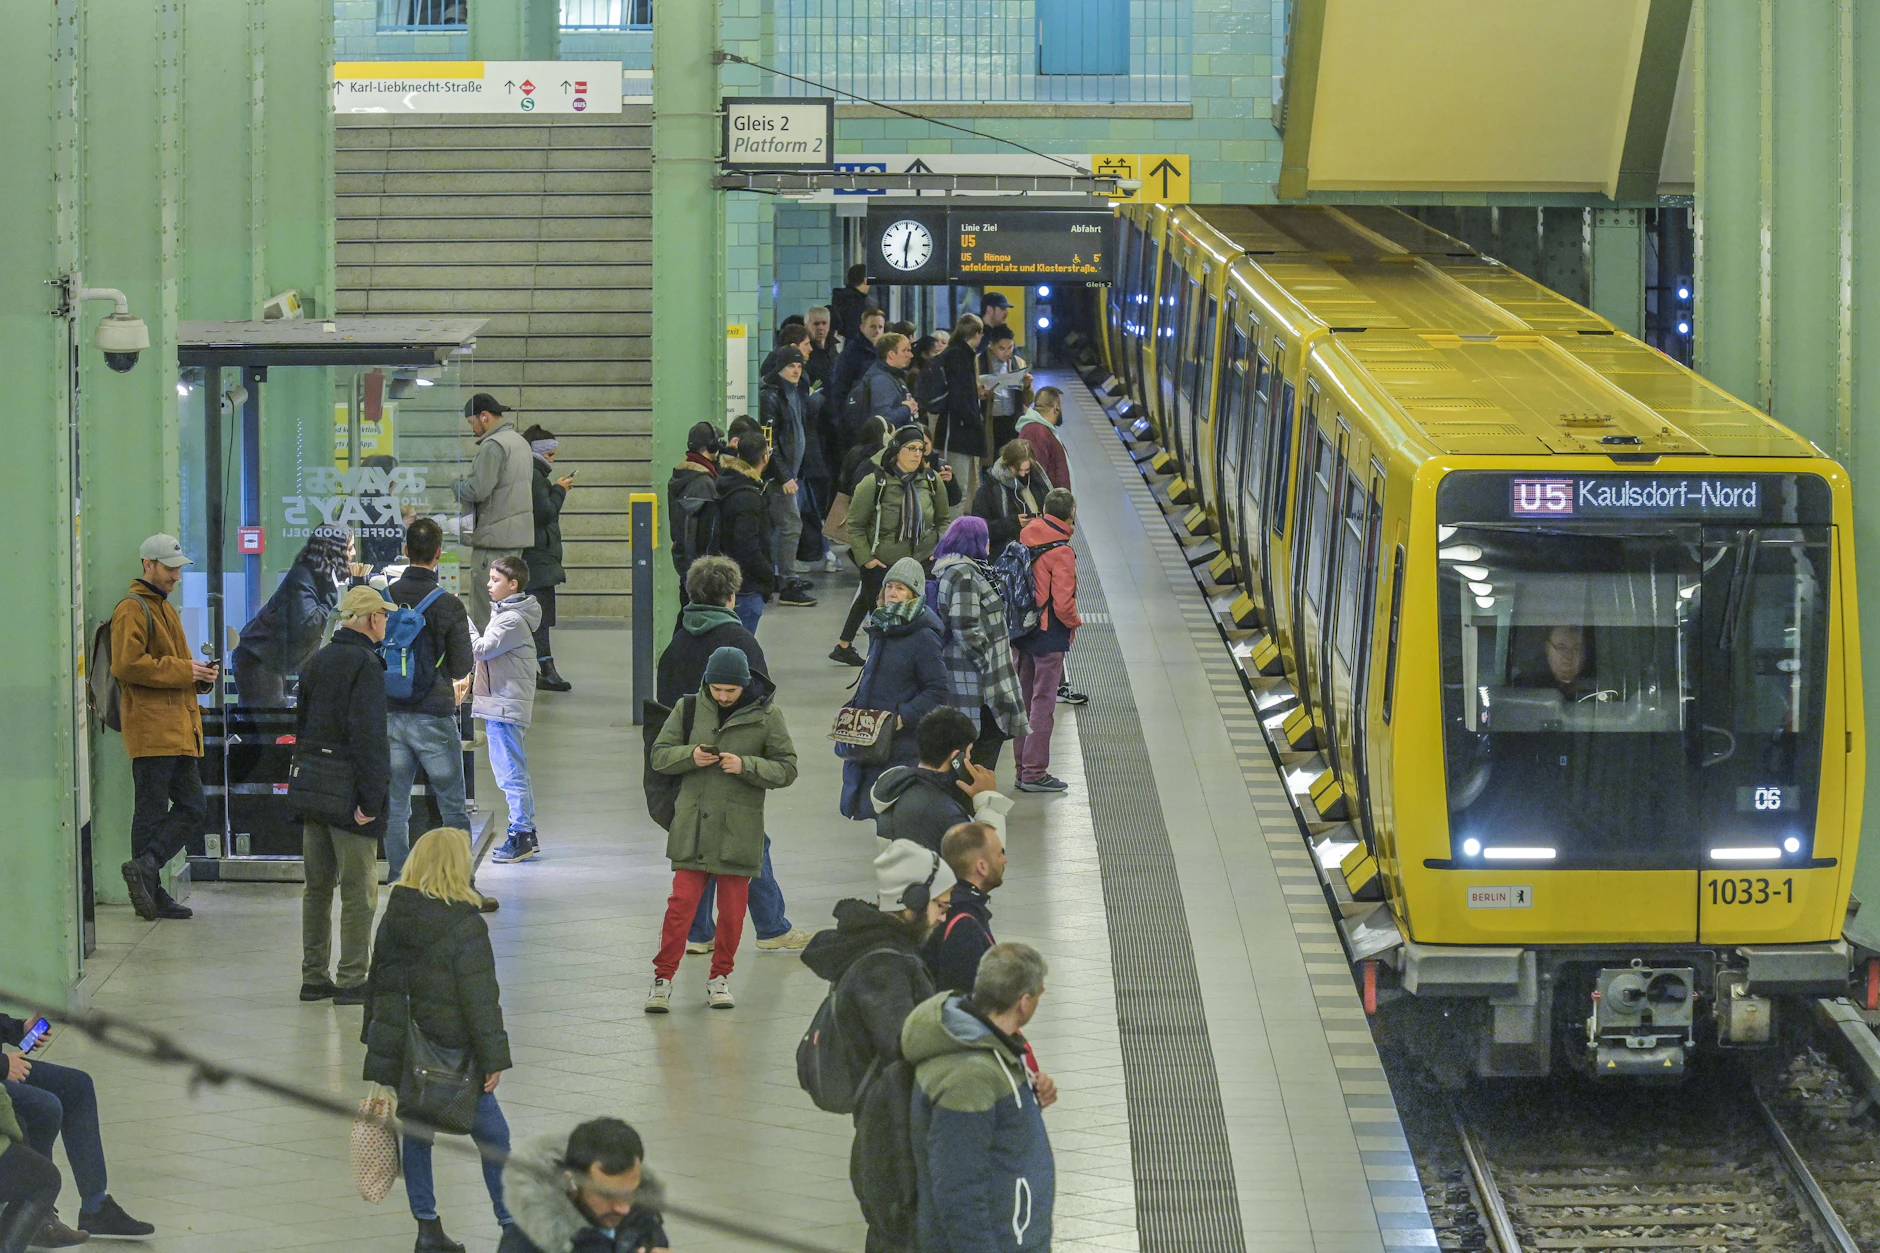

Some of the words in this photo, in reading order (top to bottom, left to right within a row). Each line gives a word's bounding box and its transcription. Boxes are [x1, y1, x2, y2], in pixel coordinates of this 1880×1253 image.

[350, 81, 482, 93] Karl-Liebknecht-Straße
[522, 98, 534, 110] S
[734, 115, 775, 131] Gleis
[780, 116, 790, 131] 2
[734, 136, 808, 153] Platform
[812, 137, 823, 153] 2
[961, 223, 980, 232] Linie
[982, 223, 998, 232] Ziel
[1070, 225, 1102, 233] Abfahrt
[961, 234, 976, 248] U5
[961, 252, 972, 262] U5
[983, 252, 1012, 262] Hönow
[1019, 263, 1036, 272] und
[1521, 484, 1567, 510] U5
[1578, 480, 1757, 507] Kaulsdorf-Nord
[1755, 787, 1781, 810] 06
[1708, 877, 1793, 905] 1033-1
[1472, 893, 1506, 902] BERLIN
